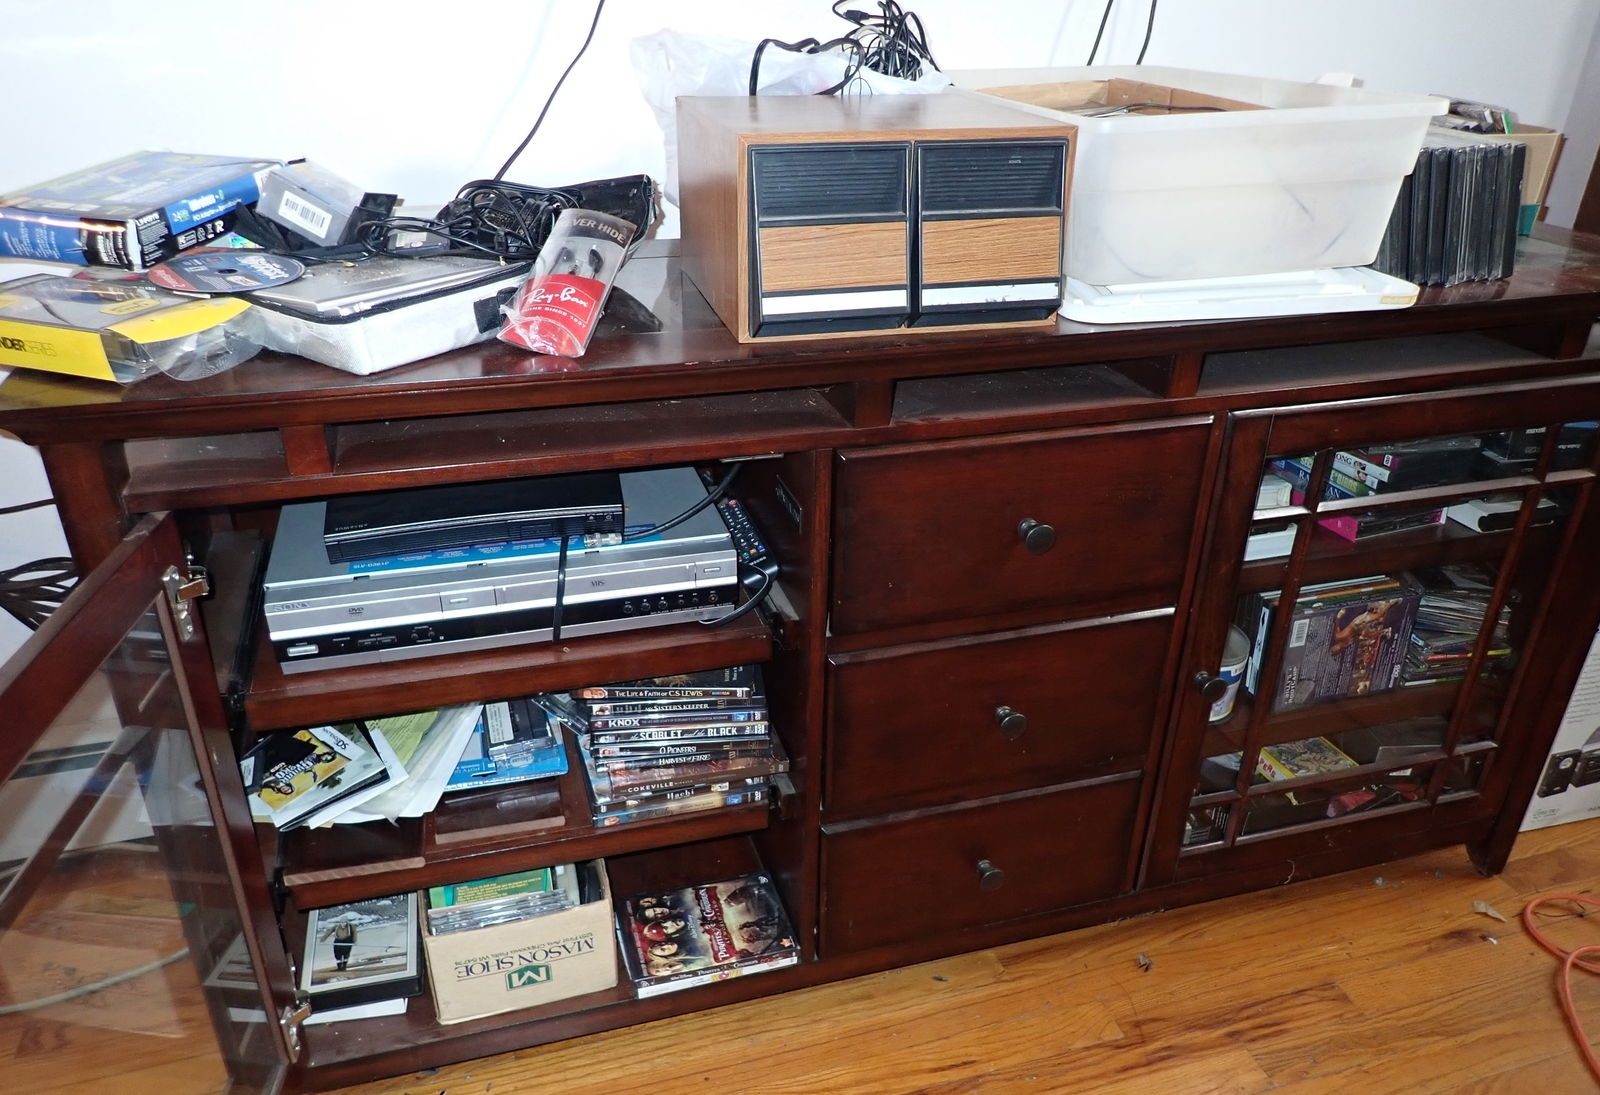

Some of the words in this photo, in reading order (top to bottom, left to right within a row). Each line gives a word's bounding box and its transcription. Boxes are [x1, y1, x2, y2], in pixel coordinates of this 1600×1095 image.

[598, 224, 625, 244] HIDE
[527, 287, 588, 308] Ray-Ban
[682, 703, 709, 711] KEEPER
[608, 718, 640, 728] KNOX
[640, 730, 683, 740] SCARLET
[707, 727, 738, 737] BLACK
[335, 738, 349, 751] DS
[659, 746, 666, 754] O
[659, 757, 686, 766] HARVEST
[691, 754, 711, 762] FIRE
[627, 781, 674, 793] COKEVILLE
[666, 789, 694, 800] Hachi
[516, 937, 595, 965] MASON
[716, 930, 730, 960] PIRATES
[454, 955, 514, 979] SHOE
[511, 966, 547, 988] M
